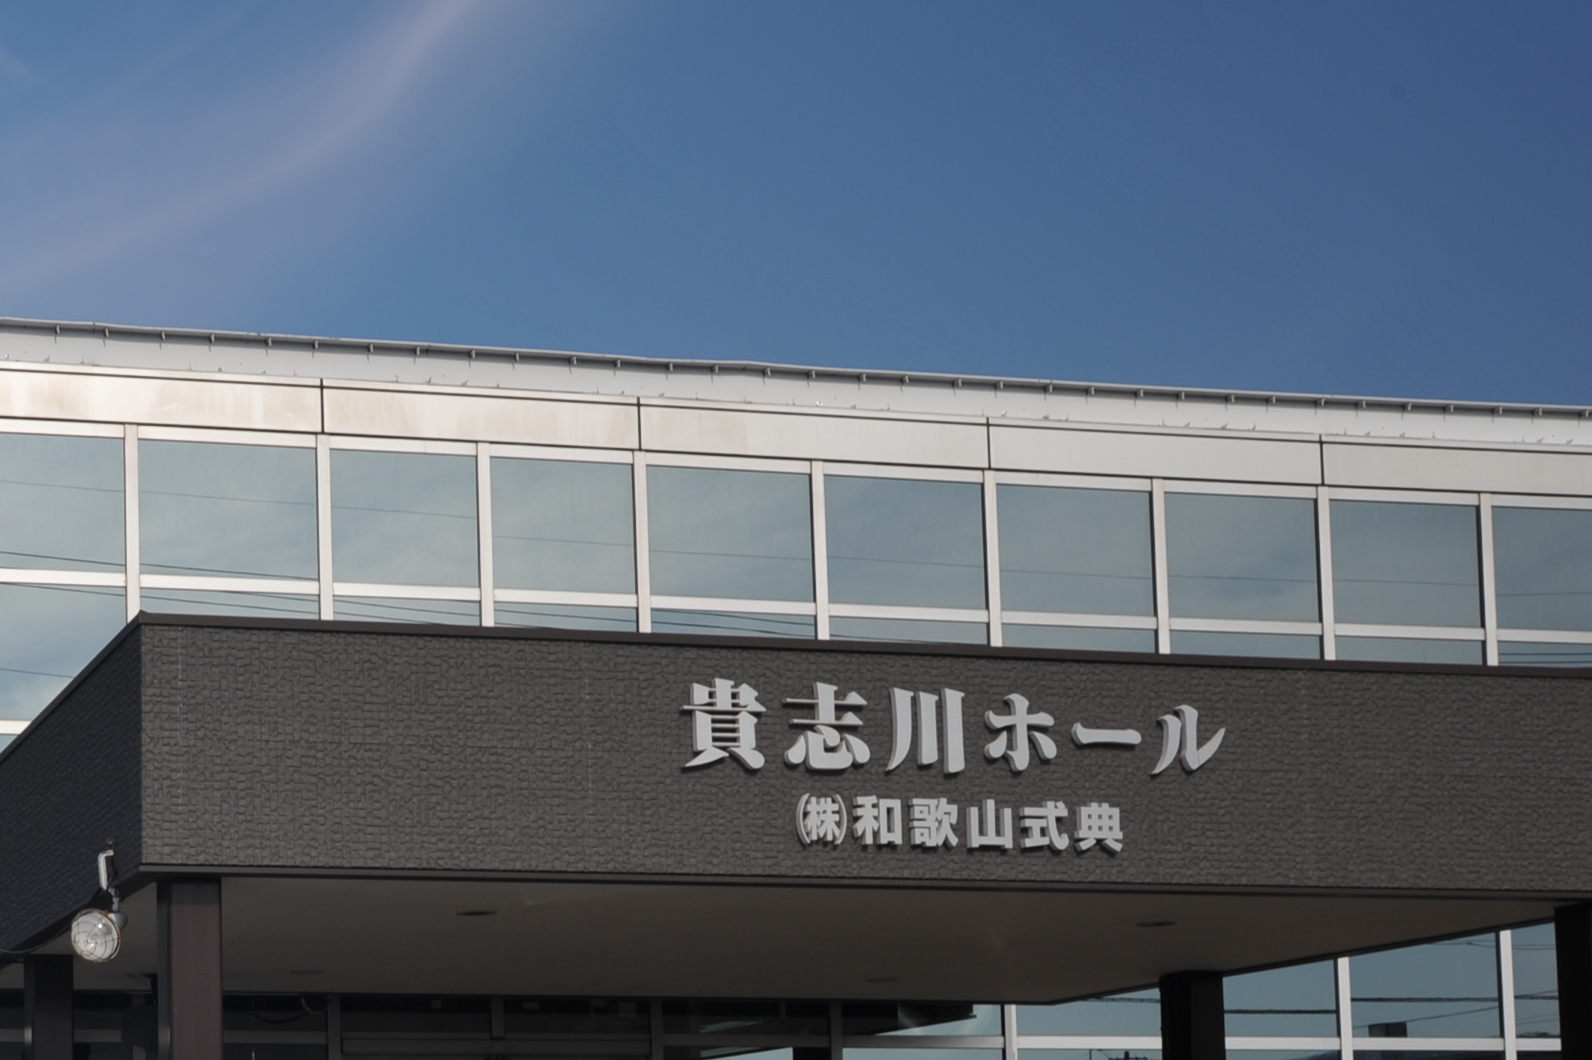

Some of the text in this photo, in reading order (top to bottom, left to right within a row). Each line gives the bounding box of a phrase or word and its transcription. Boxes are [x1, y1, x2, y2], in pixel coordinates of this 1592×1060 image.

[682, 677, 1226, 777] 貴志川ホール
